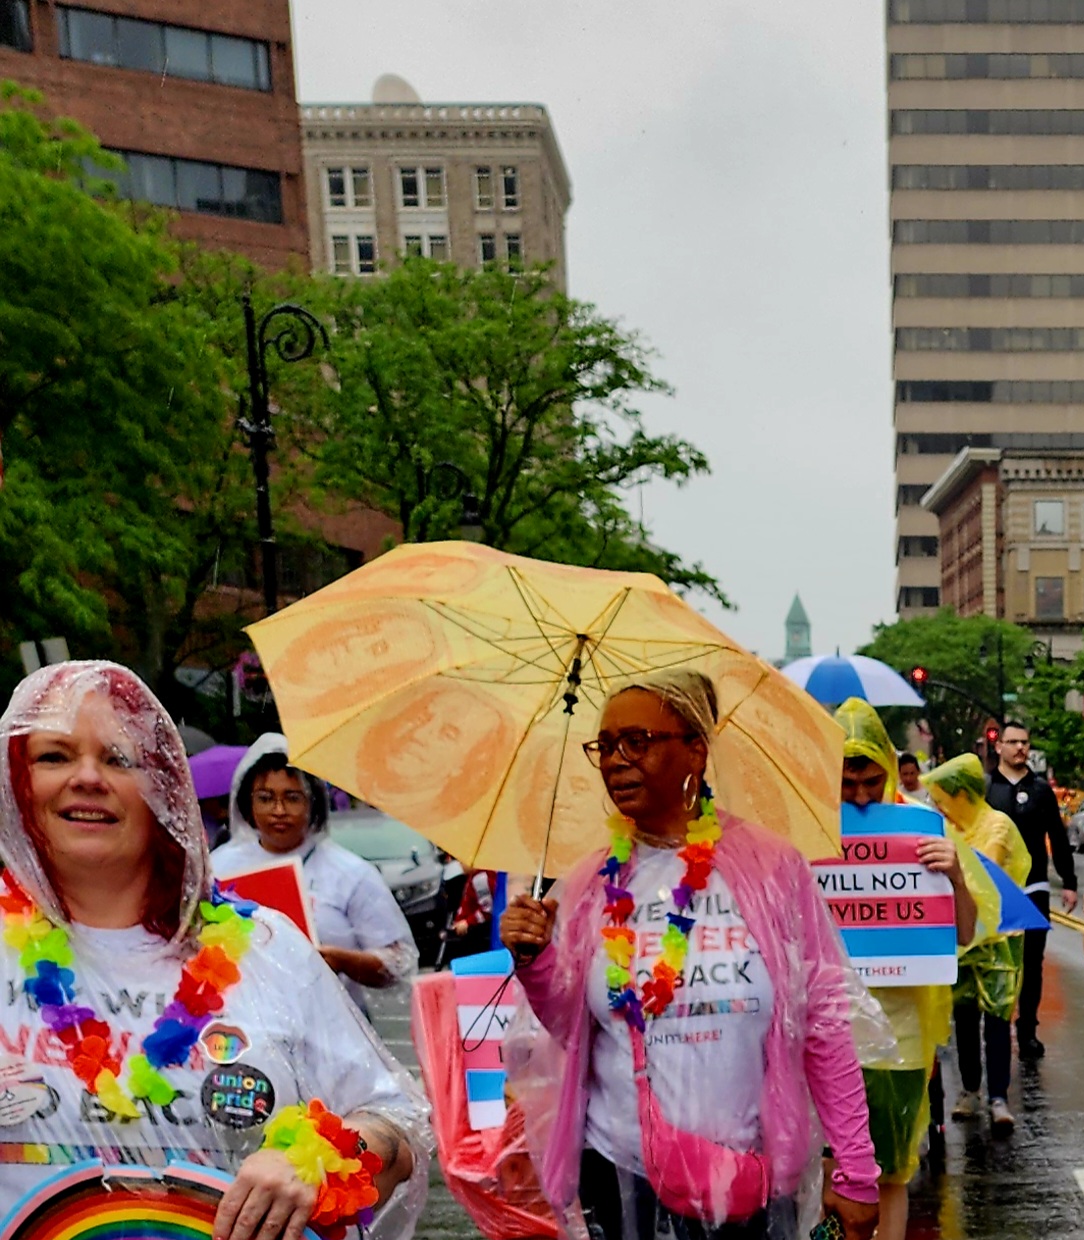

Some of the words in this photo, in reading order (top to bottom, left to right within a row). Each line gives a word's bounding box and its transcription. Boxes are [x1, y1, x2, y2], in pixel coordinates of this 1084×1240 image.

[841, 842, 888, 861] YOU
[872, 872, 922, 890] NOT
[897, 901, 925, 920] US
[213, 1070, 268, 1093] union
[211, 1090, 268, 1112] pride
